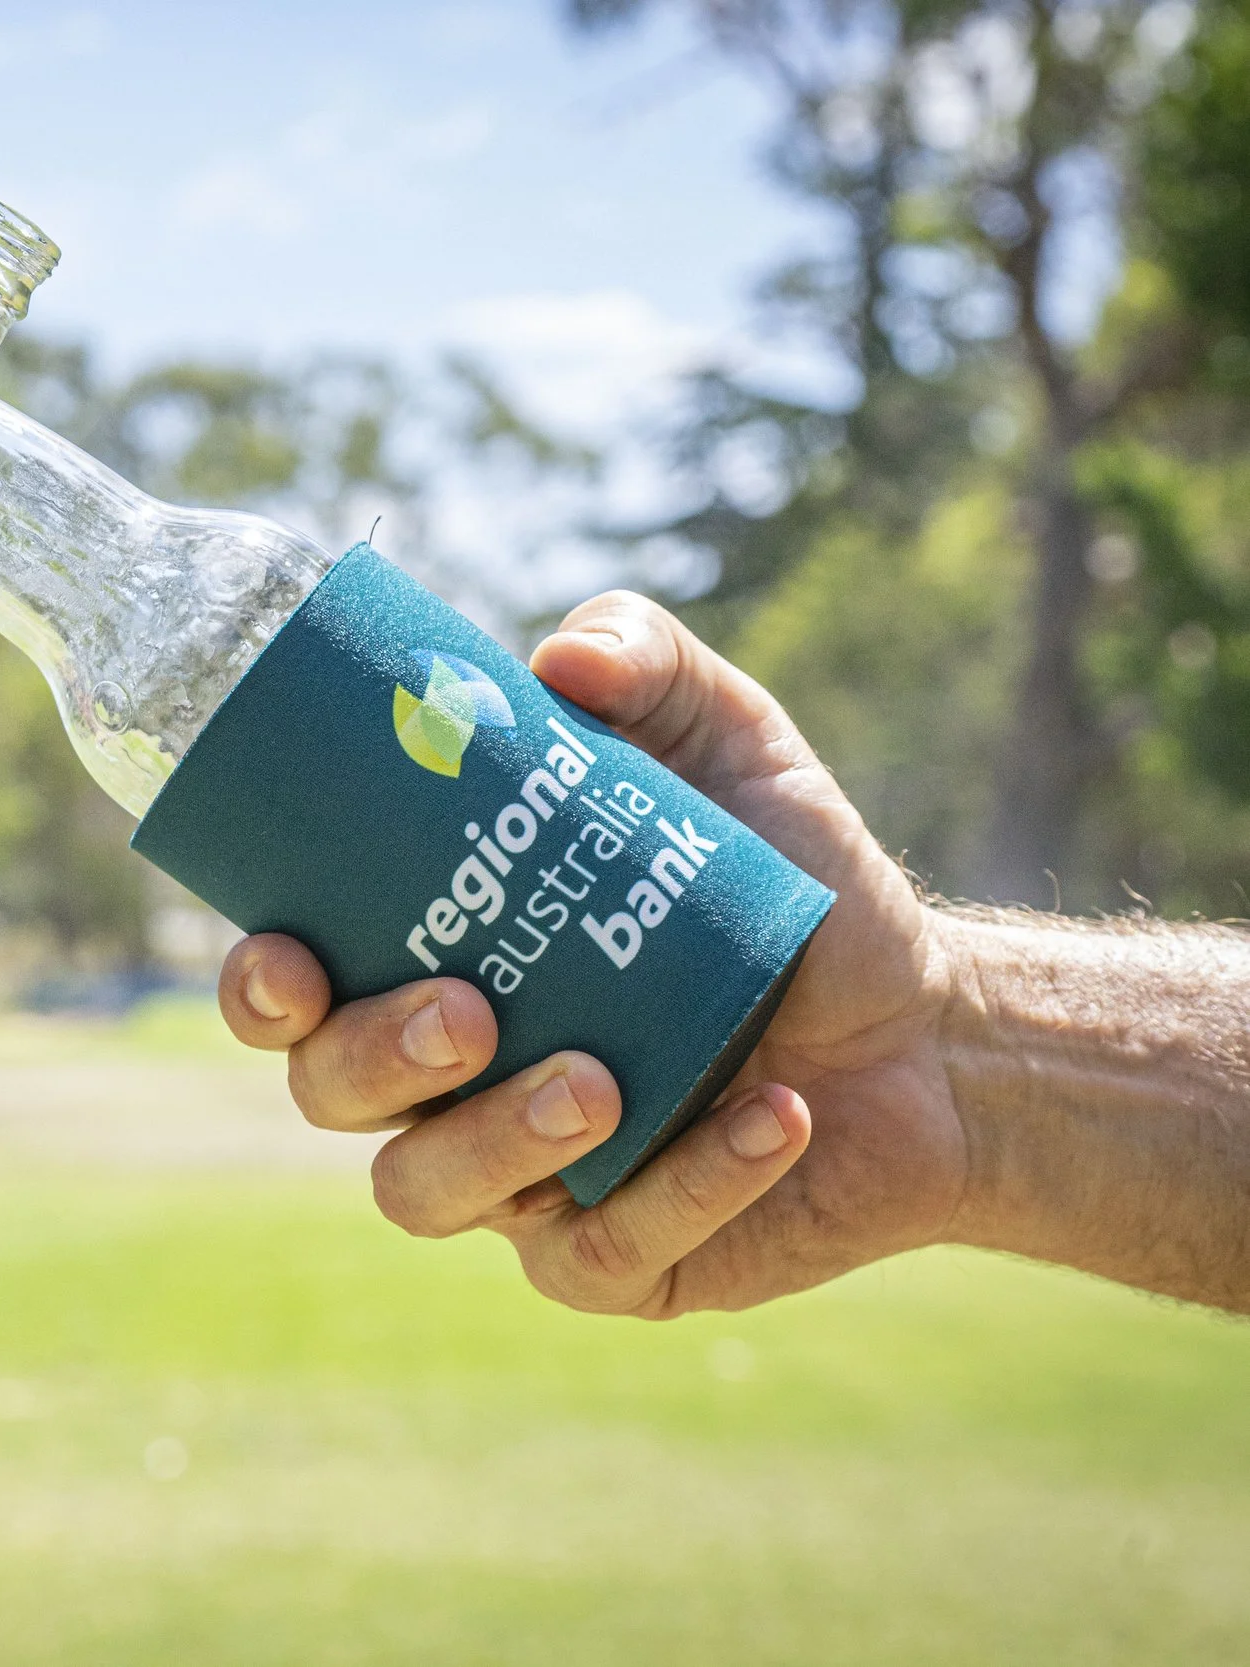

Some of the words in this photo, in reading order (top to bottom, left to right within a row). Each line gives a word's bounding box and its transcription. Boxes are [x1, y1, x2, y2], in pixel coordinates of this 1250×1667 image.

[406, 717, 597, 972] regional
[478, 780, 655, 994] australia
[579, 817, 718, 970] bank
